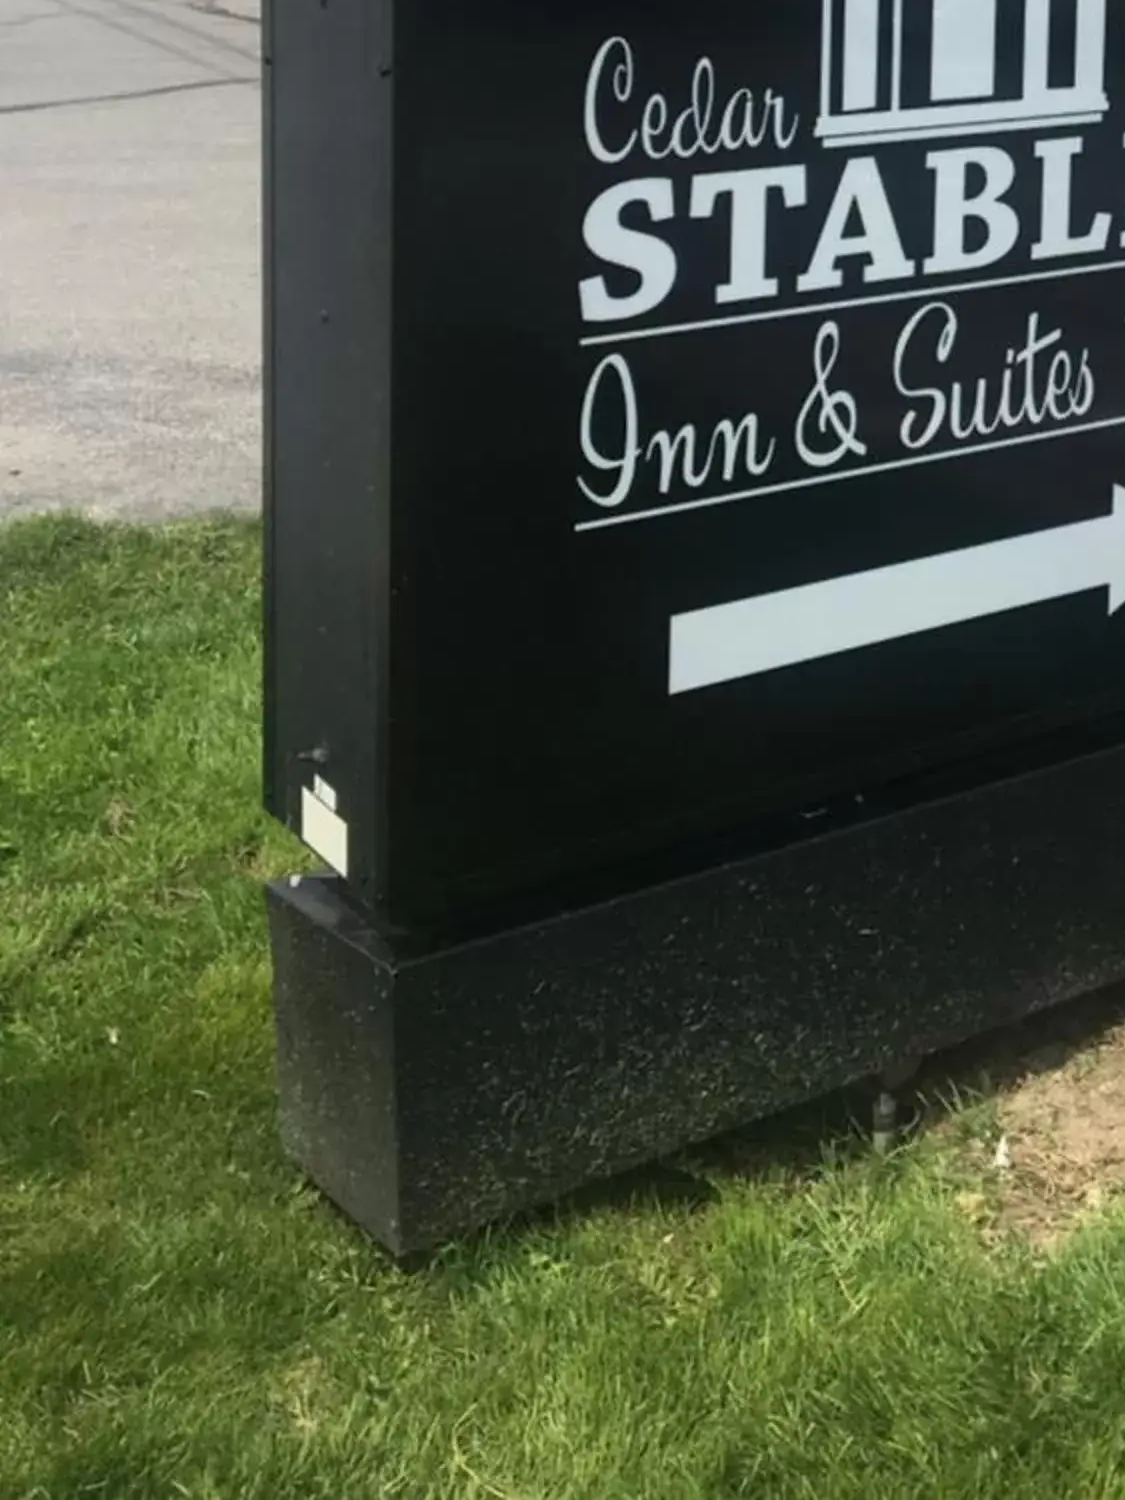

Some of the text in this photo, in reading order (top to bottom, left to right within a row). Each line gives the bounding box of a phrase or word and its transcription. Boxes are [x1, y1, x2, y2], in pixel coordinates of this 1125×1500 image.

[583, 35, 799, 164] Cedar
[576, 302, 1095, 508] Inn & Suites
